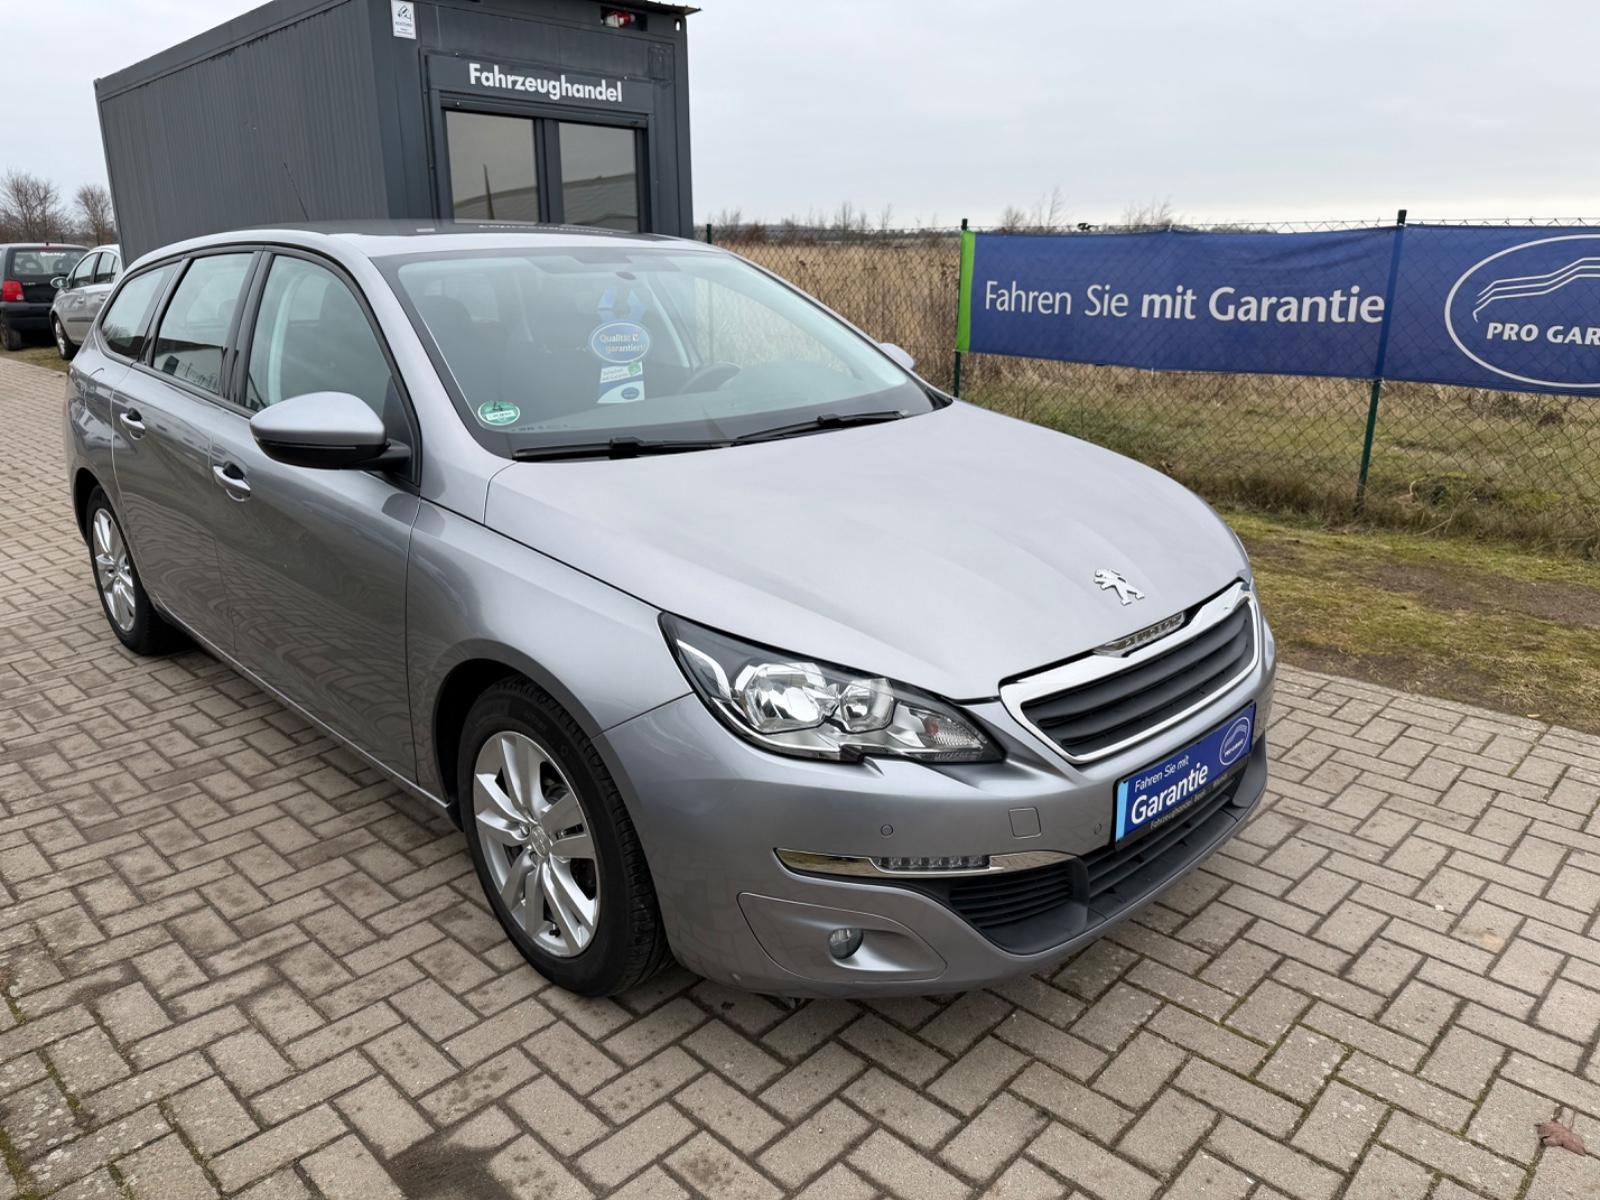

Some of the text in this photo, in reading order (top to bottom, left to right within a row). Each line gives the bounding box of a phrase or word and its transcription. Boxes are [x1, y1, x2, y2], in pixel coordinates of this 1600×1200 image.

[468, 63, 623, 102] Fahrzeughandel
[985, 280, 1385, 323] Fahren Sie mit Garantie
[1486, 322, 1539, 342] PRO
[1131, 762, 1208, 824] Garantie
[1134, 754, 1190, 793] Fahren Sie mit
